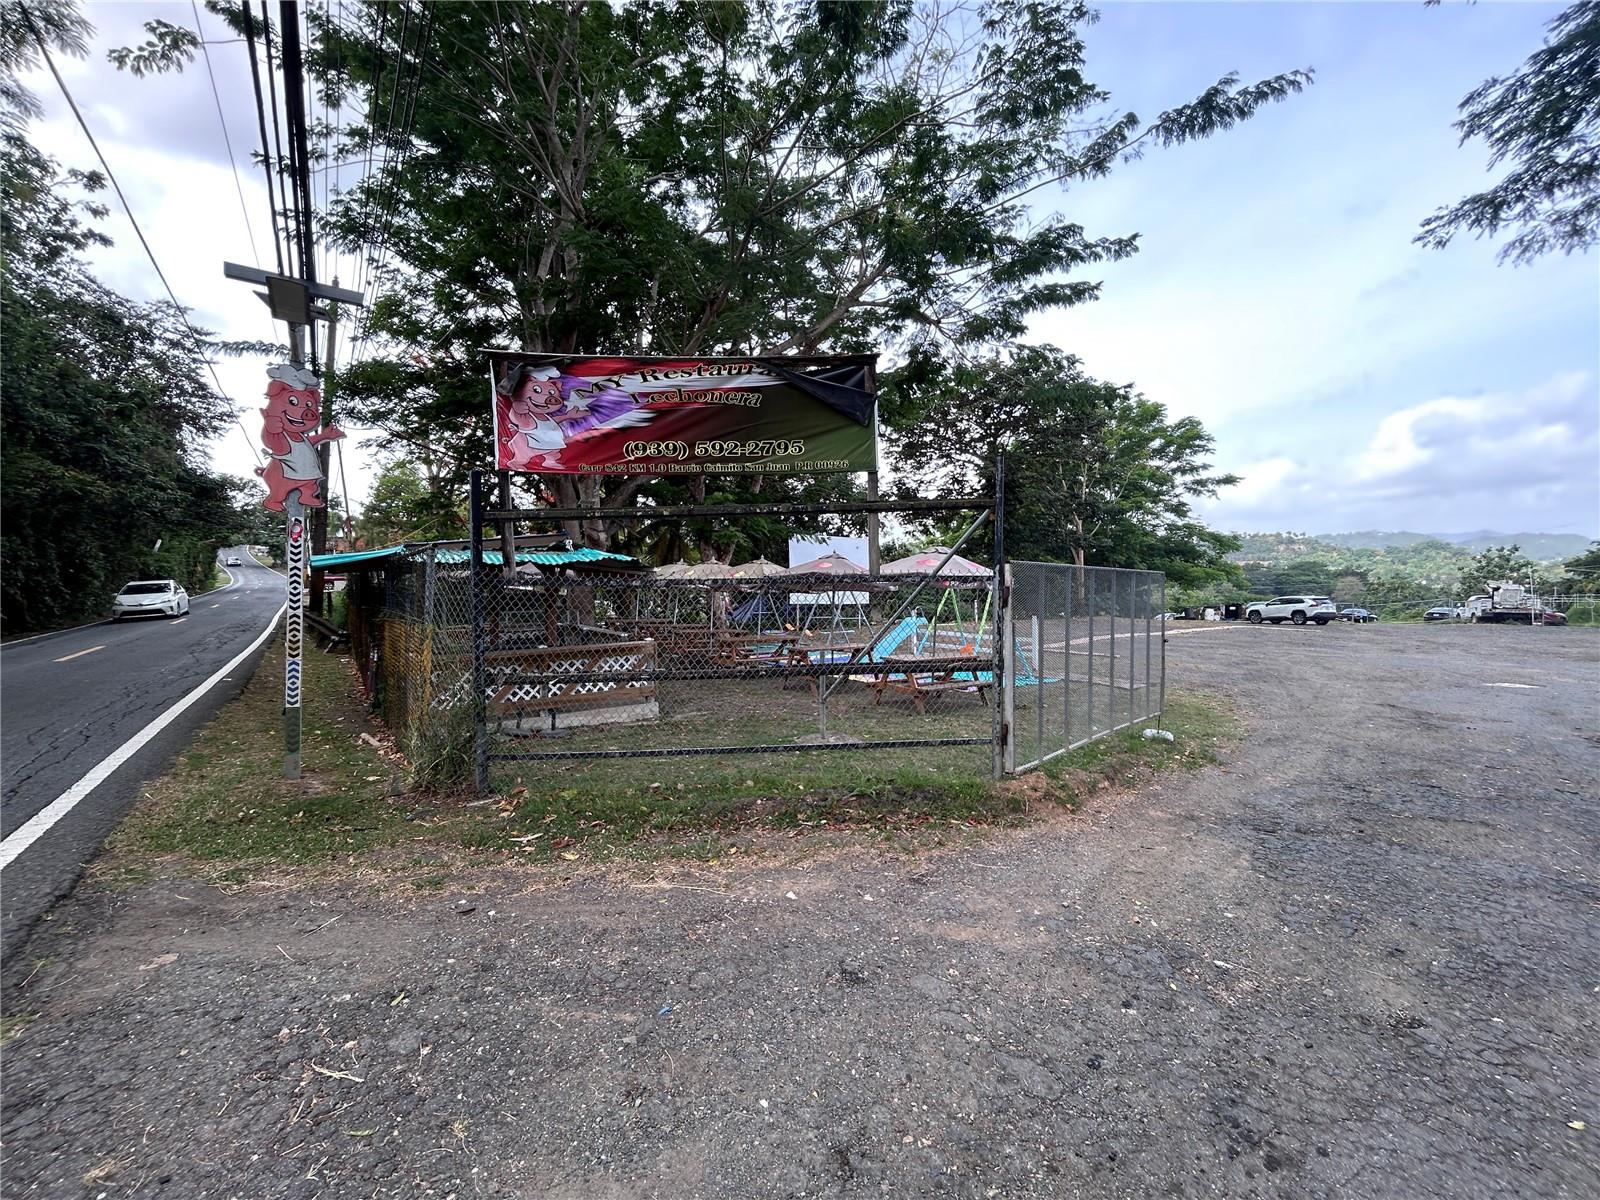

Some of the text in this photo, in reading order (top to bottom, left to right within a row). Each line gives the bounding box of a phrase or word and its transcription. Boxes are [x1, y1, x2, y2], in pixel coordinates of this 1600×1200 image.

[574, 374, 627, 399] MY
[629, 388, 762, 408] Lechonera
[623, 439, 805, 460] (939) 592-2795
[578, 463, 604, 473] Carr
[629, 463, 647, 472] KM
[649, 463, 667, 472] 1.0
[669, 463, 702, 472] Barrio
[703, 462, 743, 472] Caimito
[744, 462, 764, 472] San
[766, 462, 790, 472] Juan
[814, 460, 850, 470] 00926
